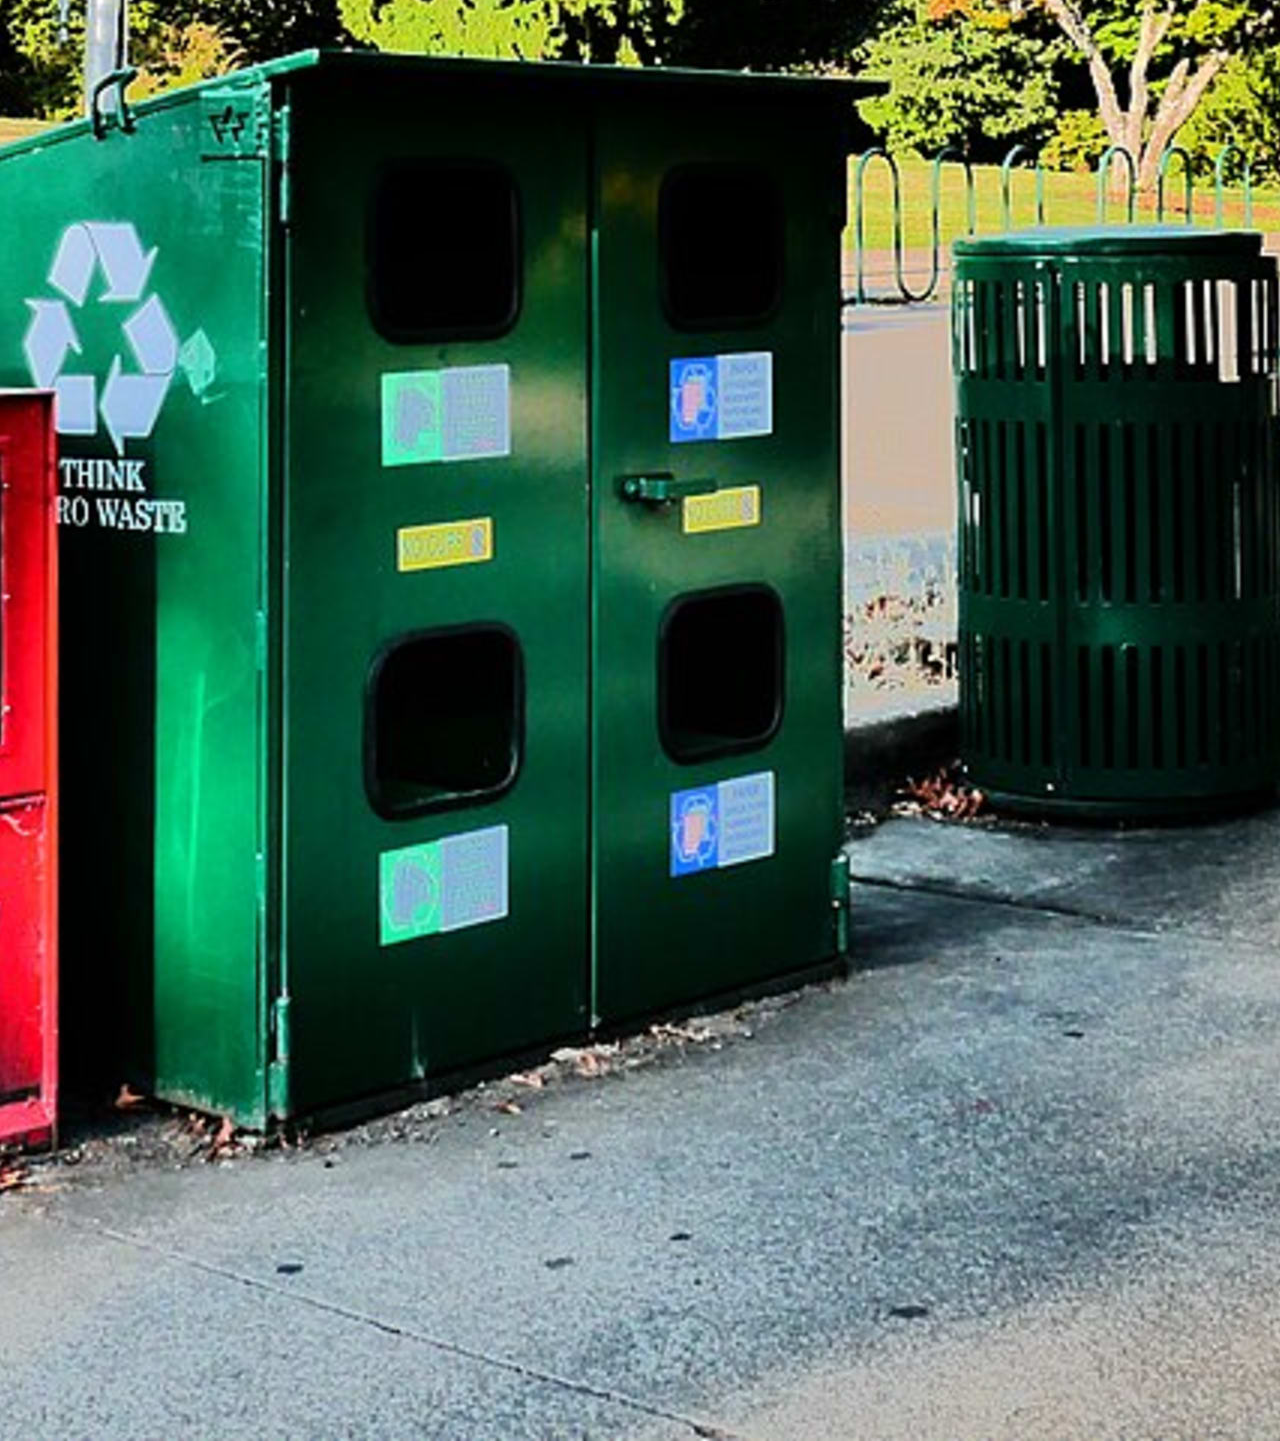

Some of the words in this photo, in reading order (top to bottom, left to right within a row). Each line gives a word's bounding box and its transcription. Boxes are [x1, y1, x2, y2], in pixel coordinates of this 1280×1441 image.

[59, 458, 146, 491] THINK
[57, 495, 89, 527] RO
[96, 498, 188, 533] WASTE
